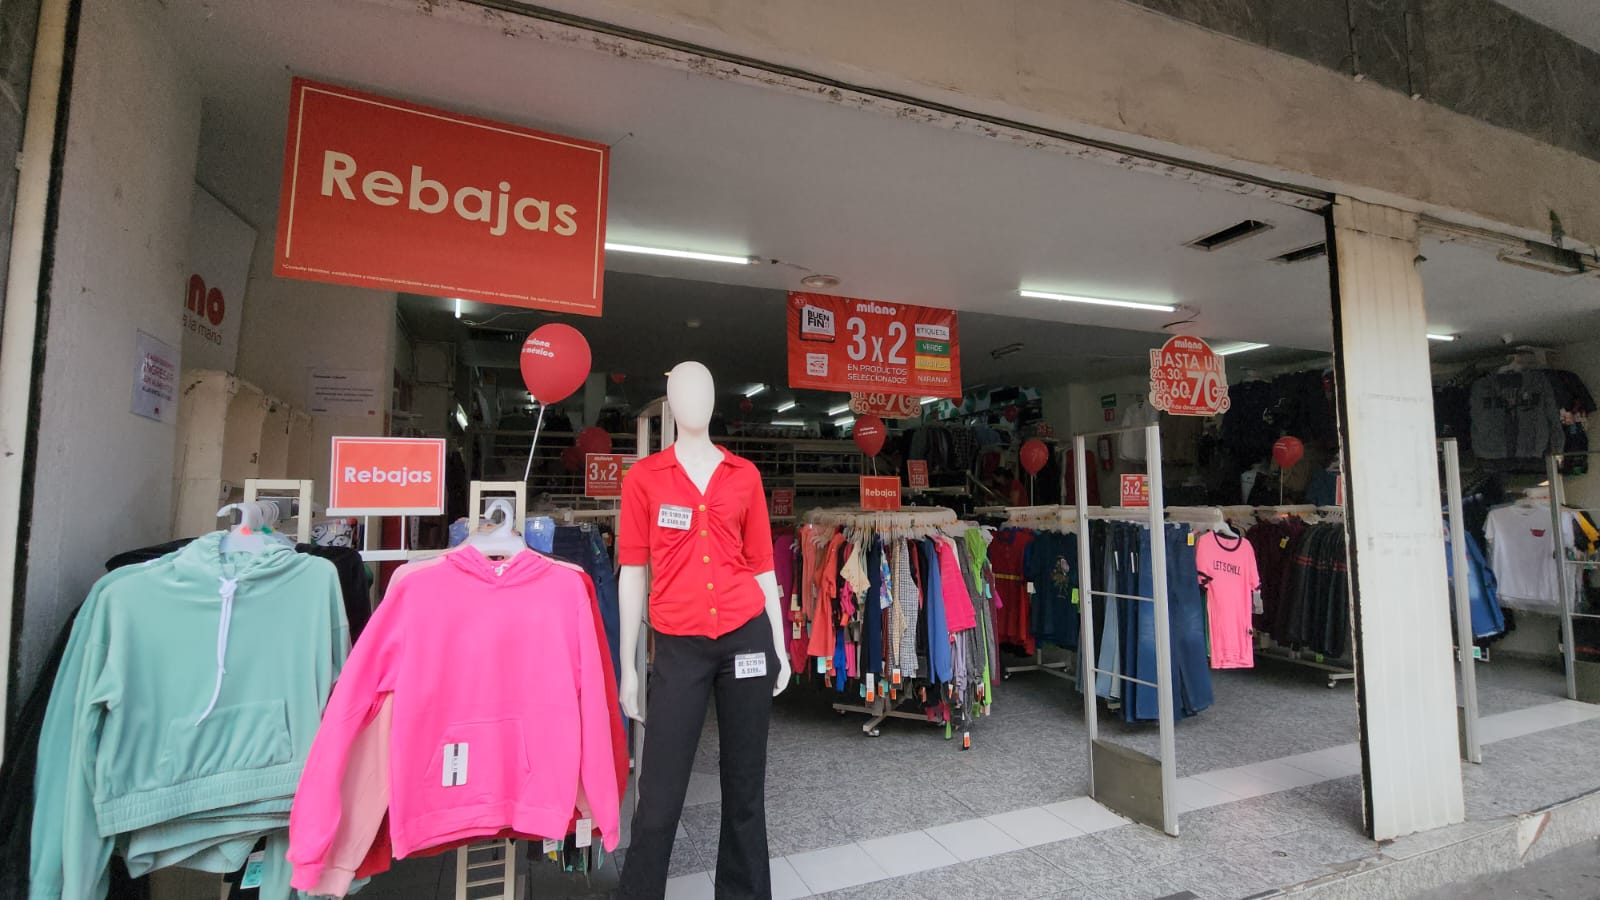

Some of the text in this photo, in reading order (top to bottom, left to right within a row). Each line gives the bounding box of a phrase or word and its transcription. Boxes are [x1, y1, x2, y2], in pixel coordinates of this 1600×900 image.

[321, 150, 577, 236] Rebajas
[183, 273, 225, 326] no
[807, 309, 830, 322] BUEN
[856, 302, 897, 316] milano
[807, 317, 825, 328] FIN
[198, 323, 223, 346] mano
[1151, 350, 1225, 371] HASTA UN
[847, 363, 908, 376] EN PRODUCTOS
[847, 373, 908, 385] SELECCIONADOS
[344, 466, 432, 487] Rebajas
[865, 488, 897, 499] Rebajas
[1213, 560, 1241, 576] LET'S CHILL
